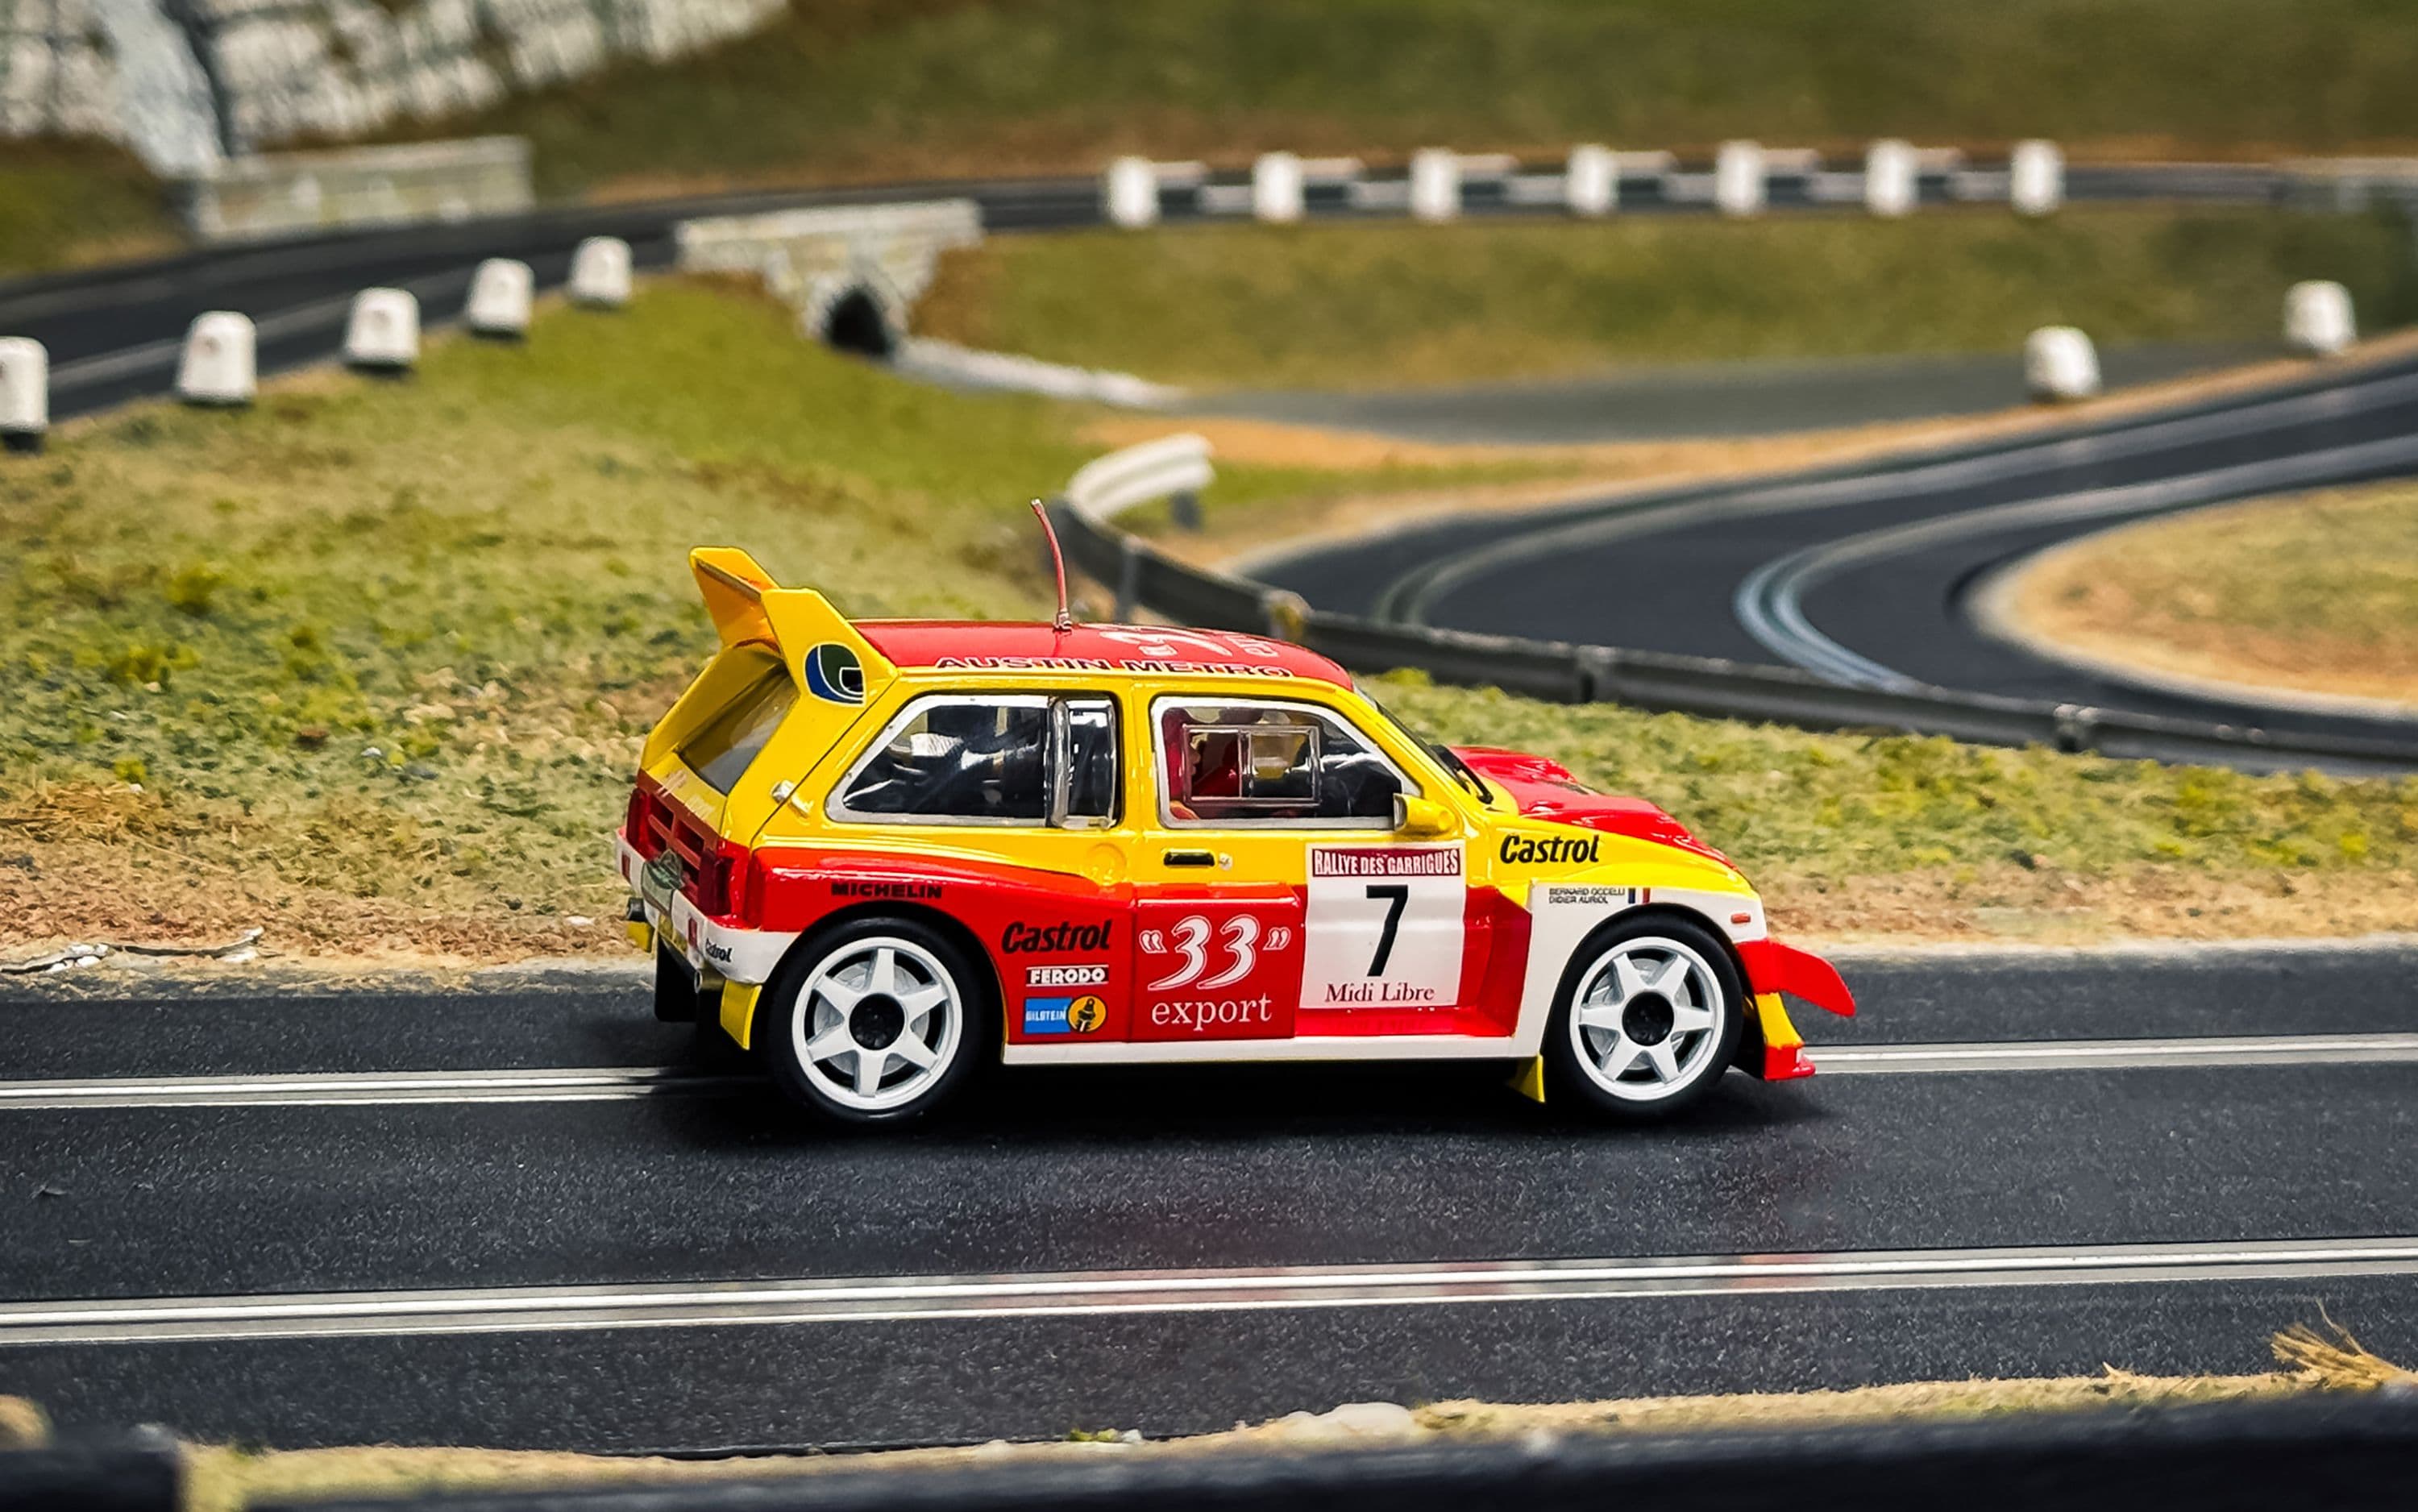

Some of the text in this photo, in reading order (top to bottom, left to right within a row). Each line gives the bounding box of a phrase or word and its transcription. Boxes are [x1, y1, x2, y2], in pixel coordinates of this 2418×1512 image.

[937, 657, 1294, 678] AUSTIN METRO
[1499, 833, 1600, 864] Castrol
[1315, 849, 1459, 874] RALLYE DES GARRIGUES
[831, 883, 942, 899] MICHELIN
[1001, 918, 1113, 954] Castrol
[1366, 884, 1409, 978] 7
[1030, 967, 1106, 984] FERODO
[1324, 982, 1435, 1003] Midi Libre
[1151, 992, 1273, 1032] export
